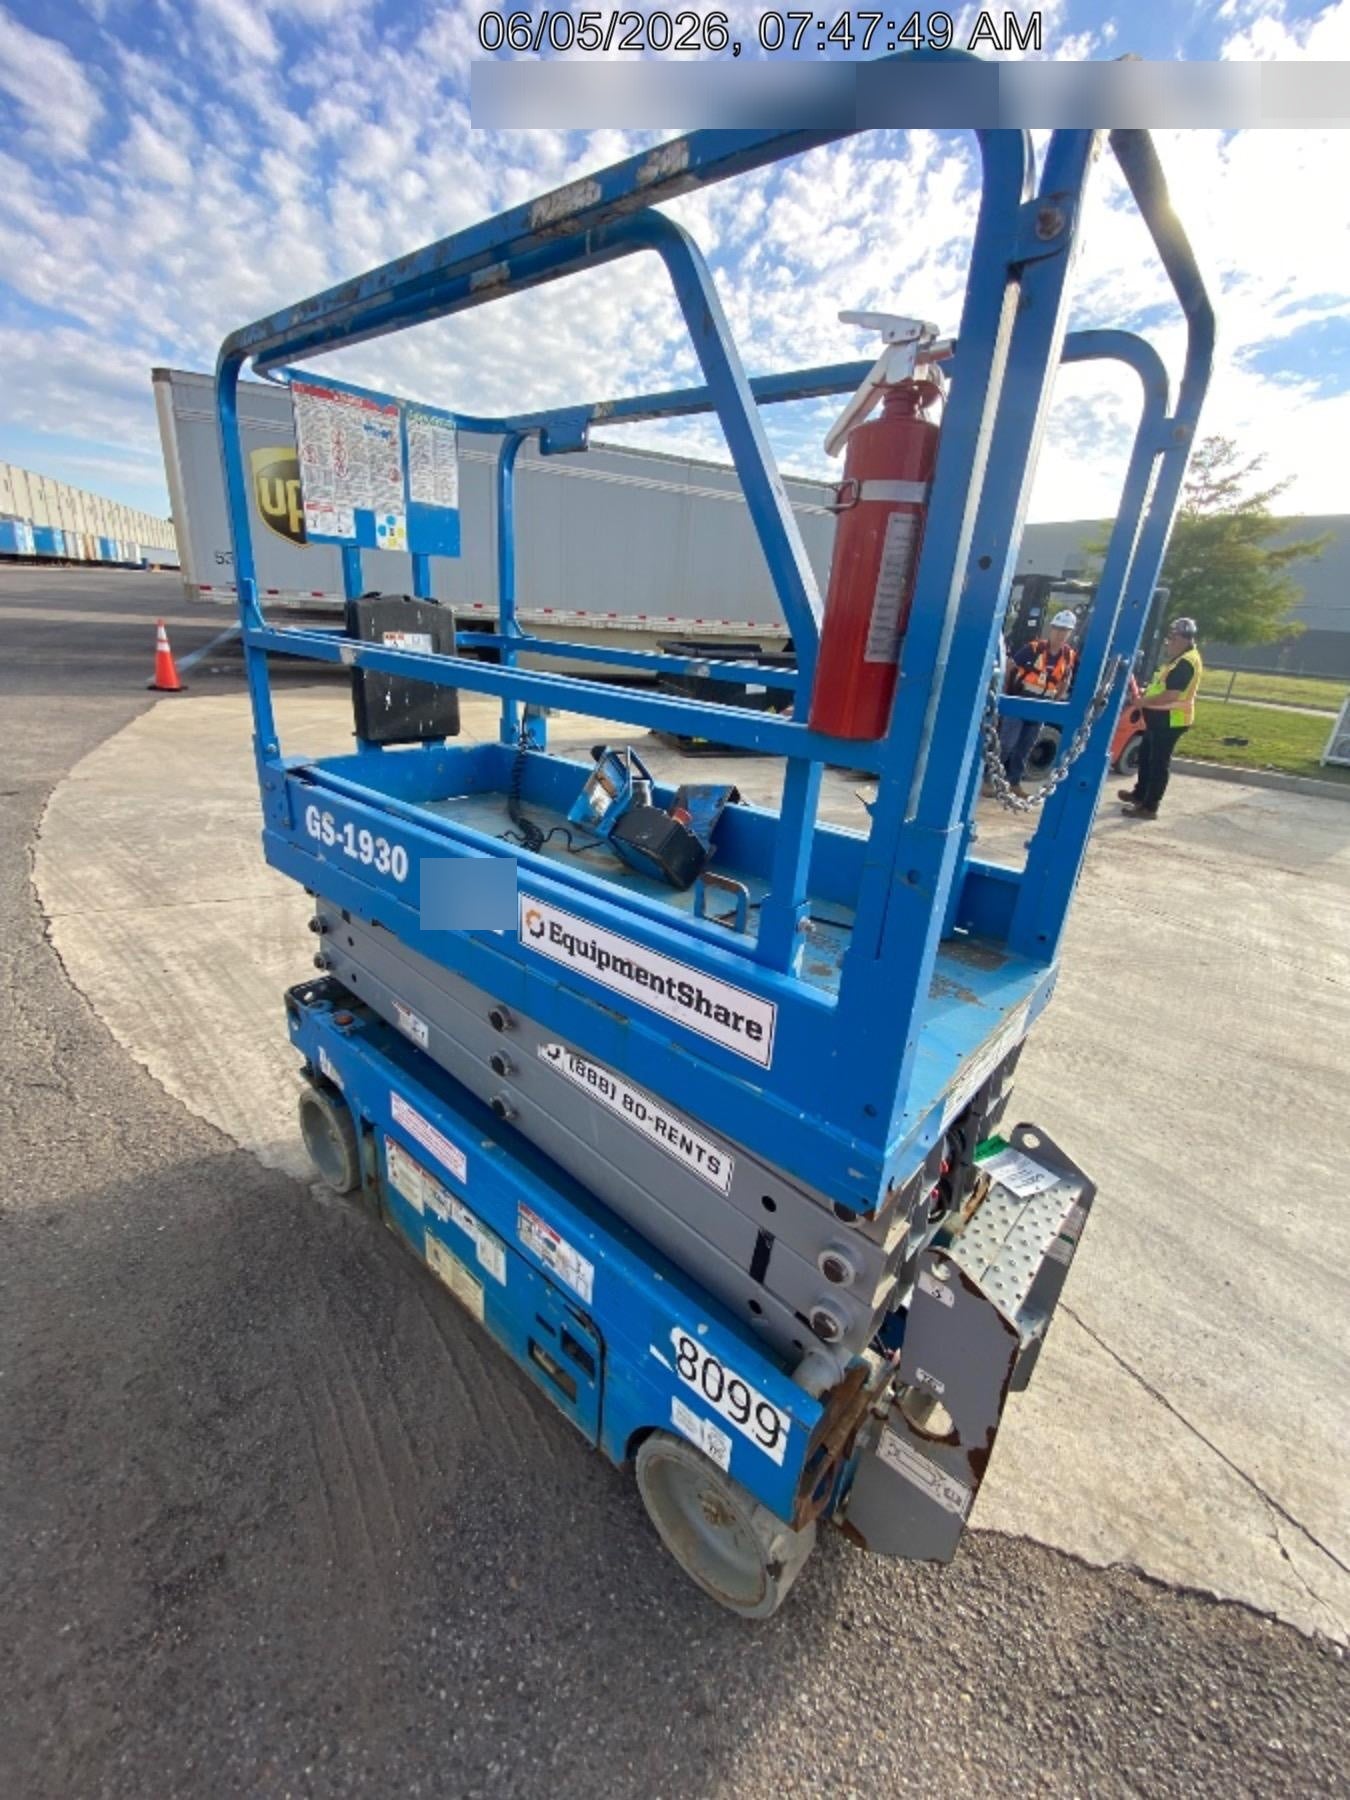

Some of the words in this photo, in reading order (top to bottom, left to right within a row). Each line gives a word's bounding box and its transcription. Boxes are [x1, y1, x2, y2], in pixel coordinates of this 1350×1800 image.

[305, 804, 409, 882] GS-1930
[549, 920, 764, 1042] EquipmentShare
[568, 1055, 617, 1100] (888)
[622, 1092, 721, 1175] 80-RENTS
[677, 1336, 781, 1449] 8099
